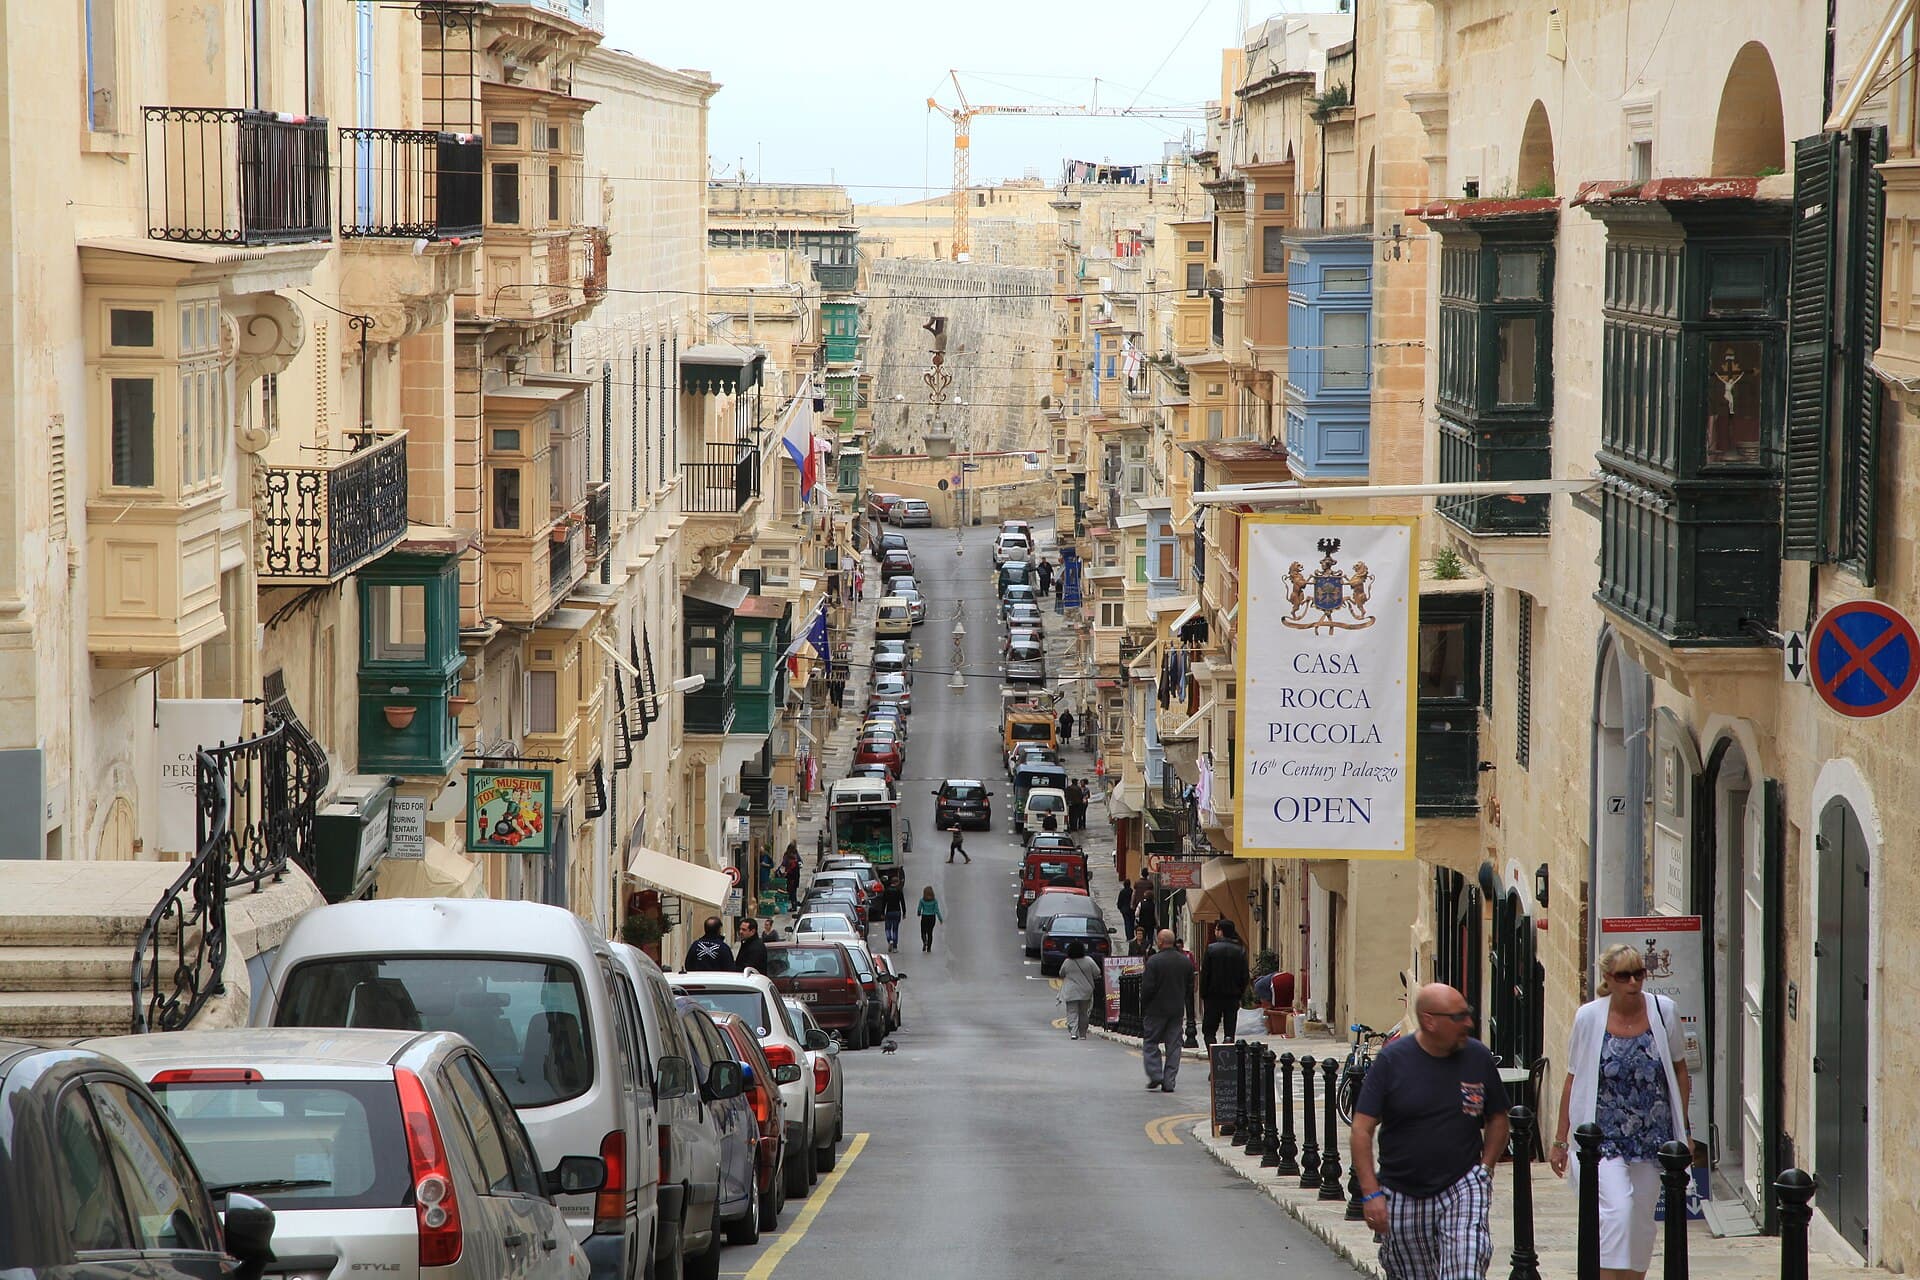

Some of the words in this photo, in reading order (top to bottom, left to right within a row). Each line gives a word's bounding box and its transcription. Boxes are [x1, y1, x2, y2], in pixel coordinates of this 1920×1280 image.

[1293, 653, 1360, 674] CASA
[1280, 688, 1371, 709] ROCCA
[1268, 723, 1382, 744] PICCOLA
[1251, 759, 1277, 776] 16th
[1282, 760, 1337, 782] Century
[1342, 761, 1398, 783] Palazzo
[475, 776, 491, 792] The
[478, 789, 495, 805] TOY
[495, 778, 542, 791] MUSEUM
[411, 802, 424, 810] FOR
[1274, 796, 1372, 824] OPEN
[393, 825, 418, 833] ENTARY
[395, 834, 422, 842] SITTINGS
[1648, 987, 1680, 995] ROCCA
[351, 1263, 400, 1271] STYLE
